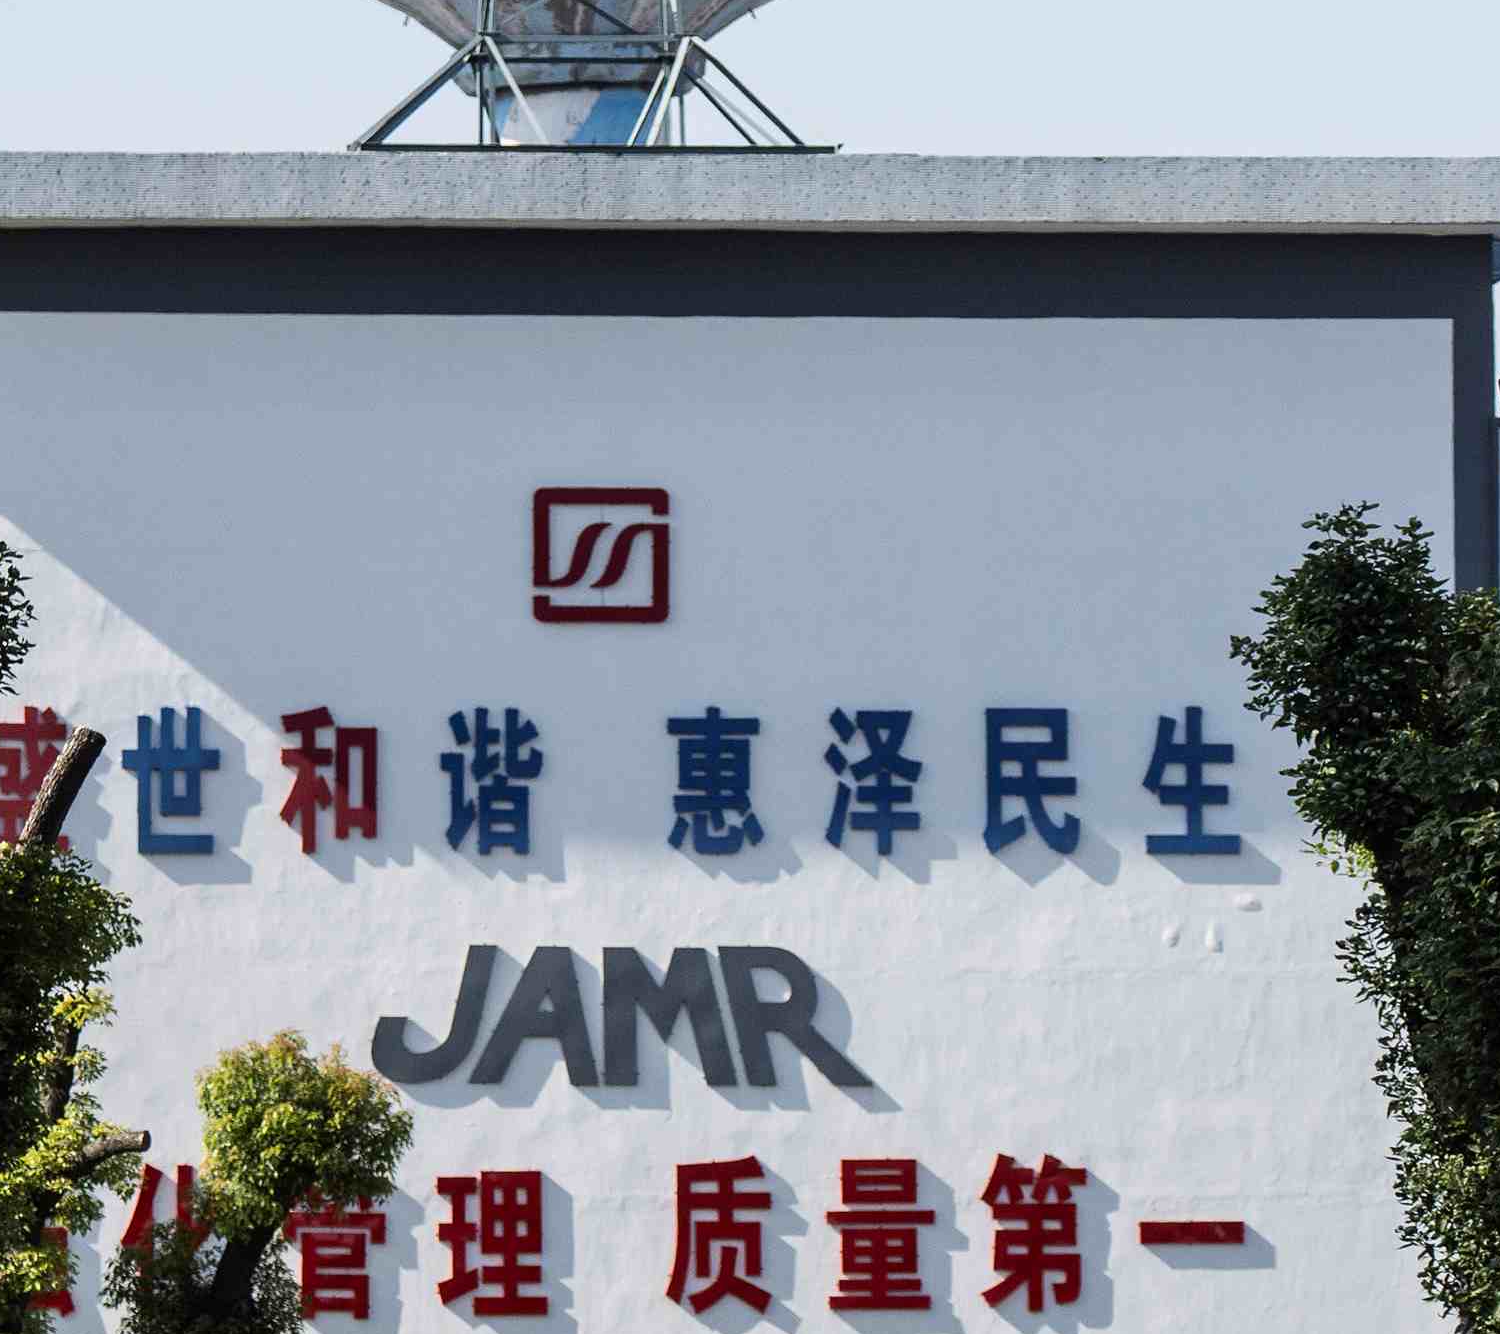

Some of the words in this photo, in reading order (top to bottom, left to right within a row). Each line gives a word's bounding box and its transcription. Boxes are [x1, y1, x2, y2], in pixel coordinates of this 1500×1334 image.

[667, 705, 1242, 856] 惠泽民生
[371, 943, 873, 1088] JAMR
[664, 1154, 1245, 1315] 质量第一
